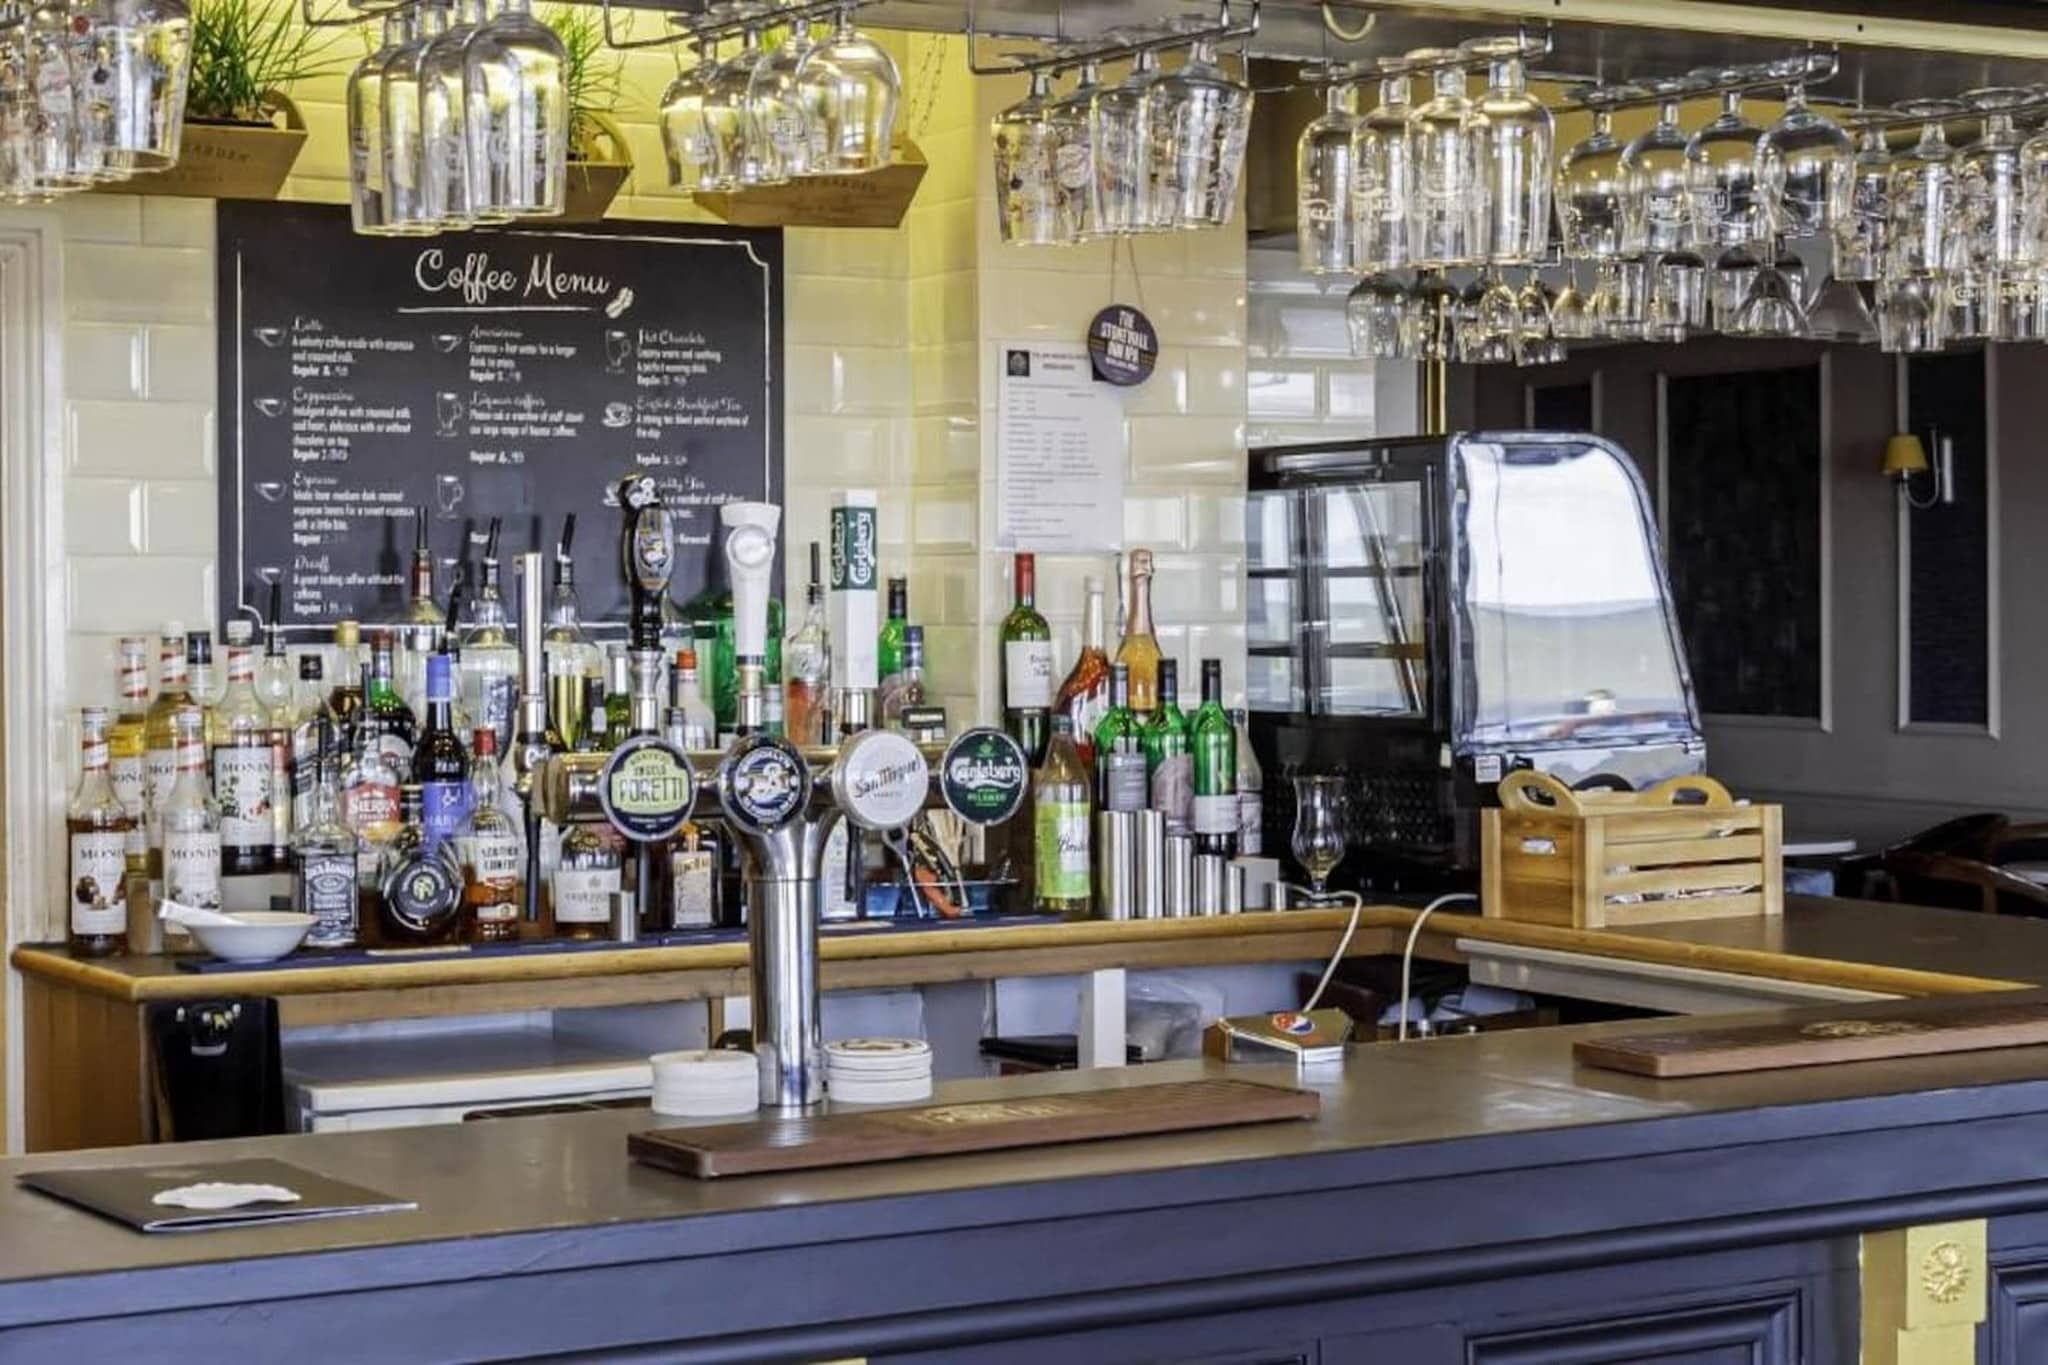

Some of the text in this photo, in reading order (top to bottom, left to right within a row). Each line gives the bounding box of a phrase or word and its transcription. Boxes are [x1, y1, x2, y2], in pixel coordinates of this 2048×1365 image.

[415, 249, 609, 305] Coffee Menu
[849, 511, 876, 585] Carlsberg
[618, 776, 684, 803] PORETTI
[950, 756, 1021, 789] Carlsberg
